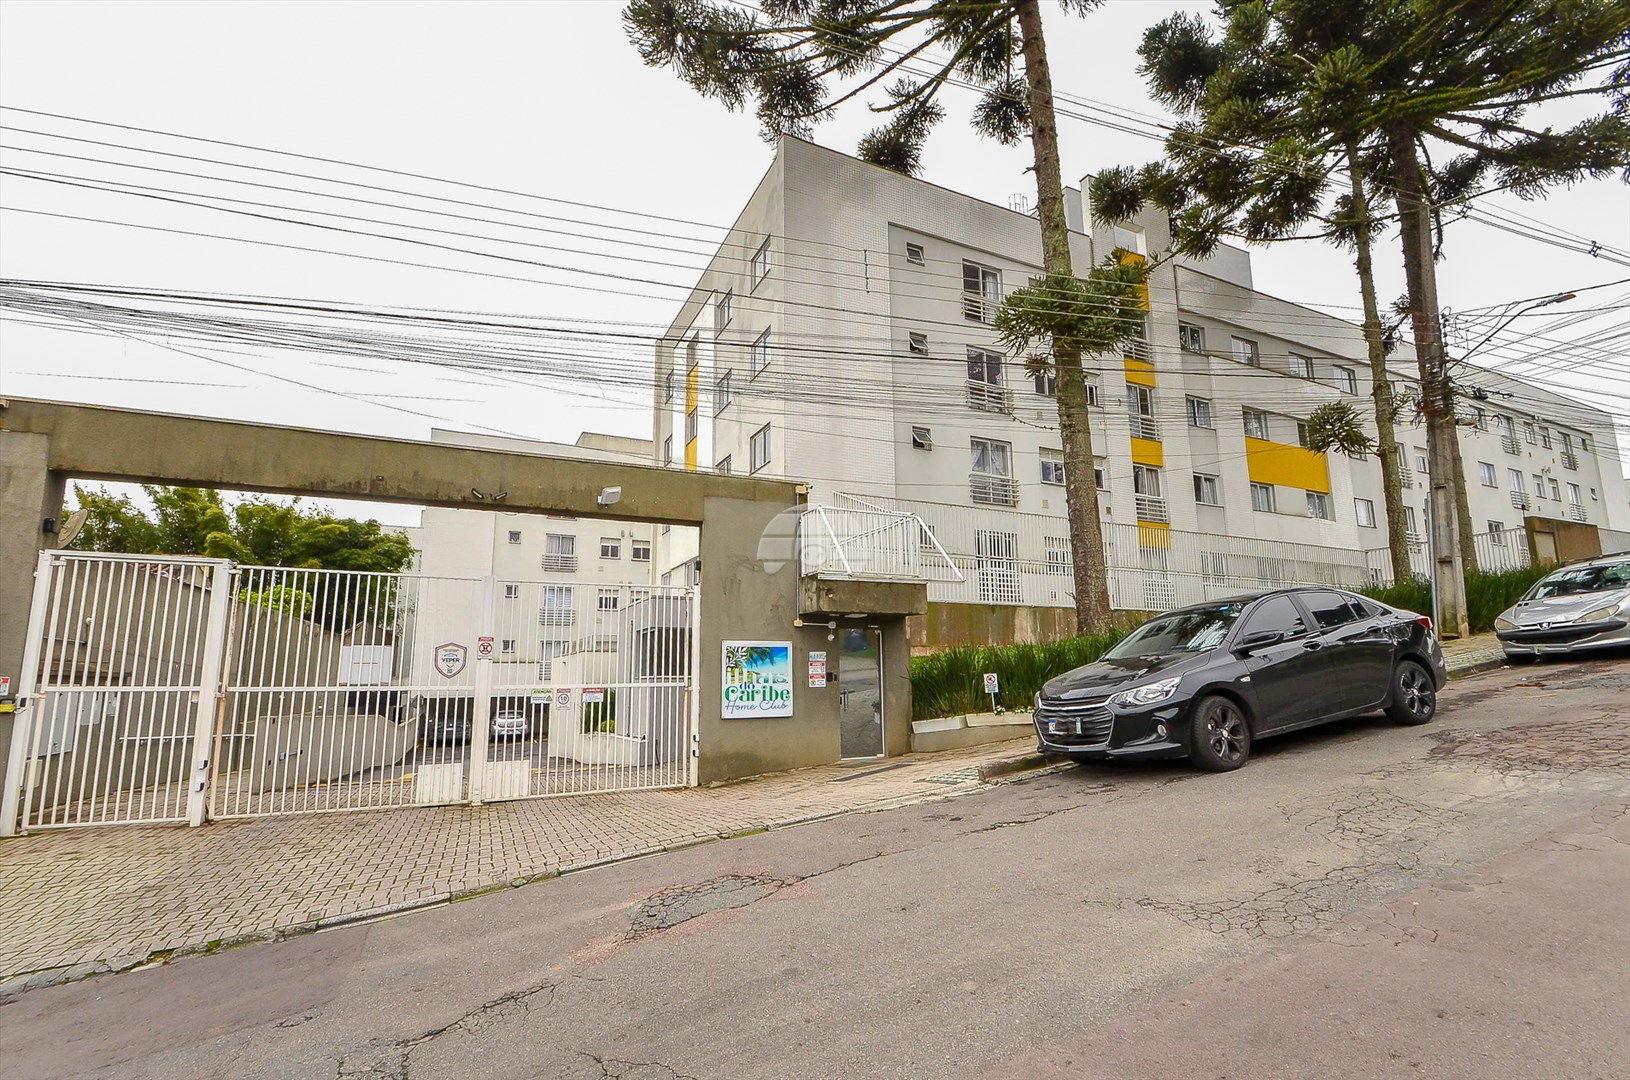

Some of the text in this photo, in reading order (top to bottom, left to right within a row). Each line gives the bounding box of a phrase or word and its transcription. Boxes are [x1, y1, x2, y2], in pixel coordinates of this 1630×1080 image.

[724, 685, 790, 702] Caribe
[739, 681, 756, 690] do
[725, 695, 788, 714] Home Club
